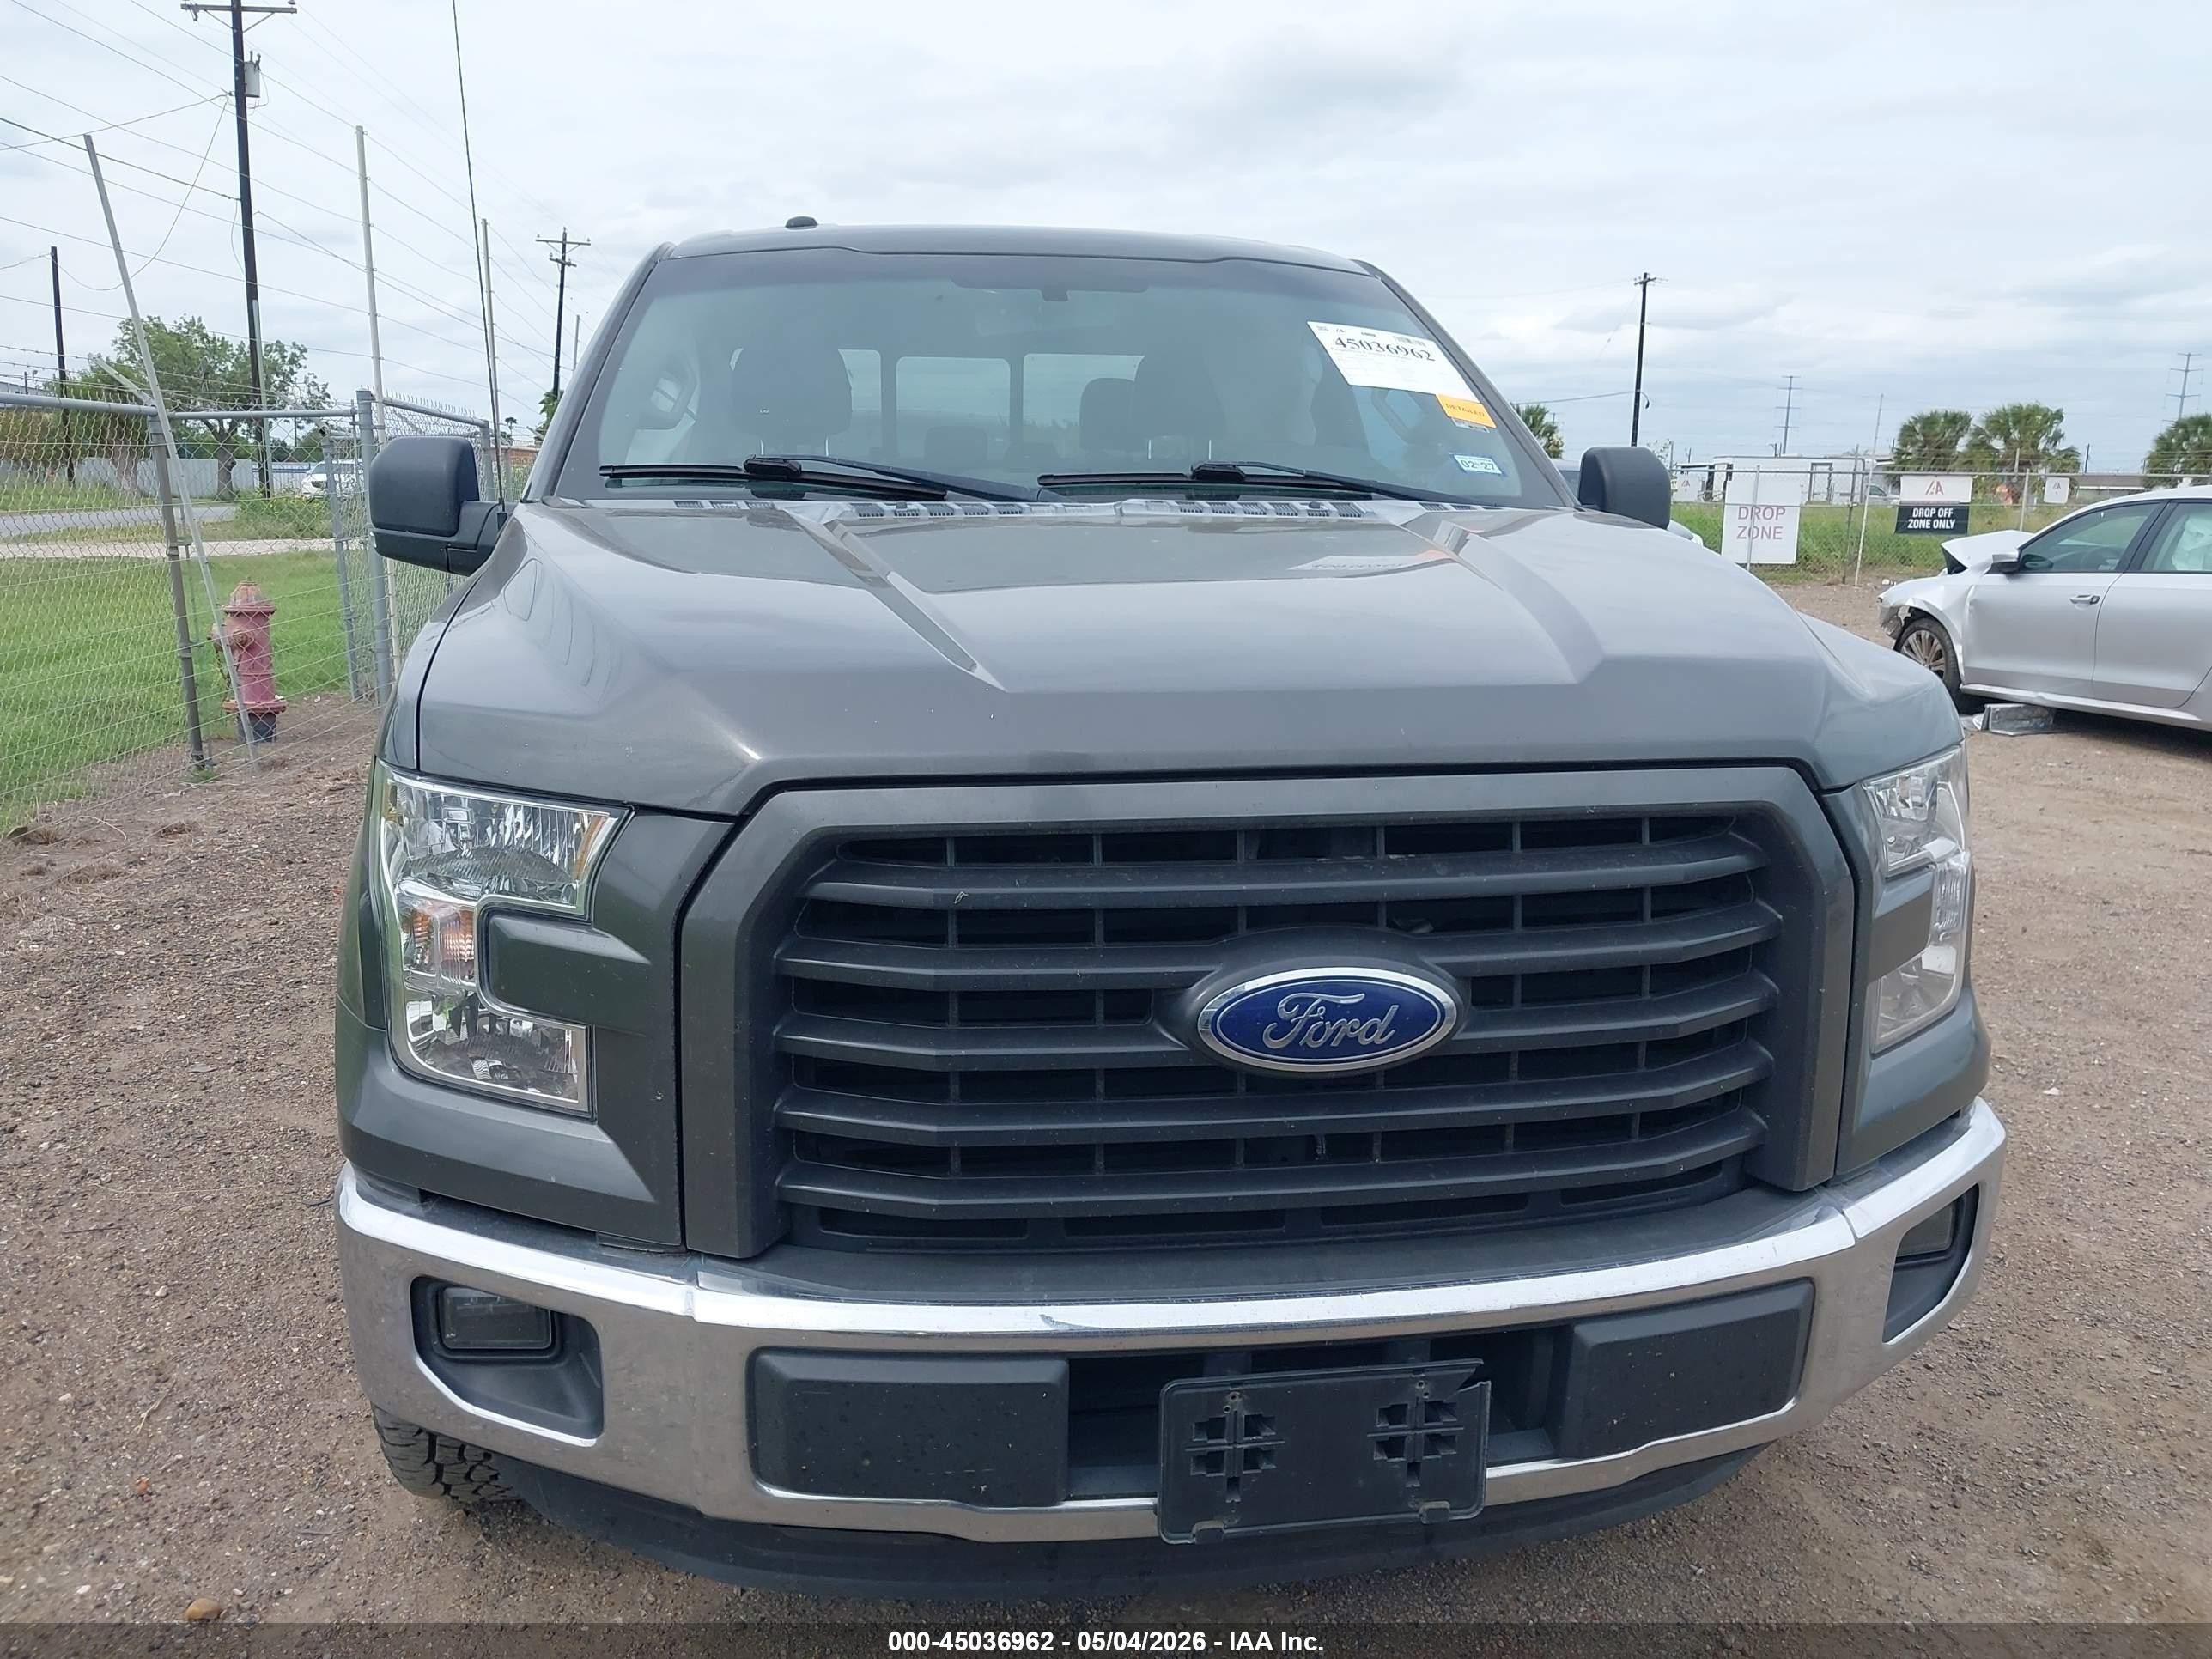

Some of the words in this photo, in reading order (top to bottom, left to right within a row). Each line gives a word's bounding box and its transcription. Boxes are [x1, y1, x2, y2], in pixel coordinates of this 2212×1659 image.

[1335, 336, 1436, 362] 45036962
[1461, 459, 1478, 469] 02
[1738, 506, 1786, 520] DROP
[1912, 507, 1936, 518] DROP
[1937, 507, 1954, 518] OFF
[1907, 519, 1931, 529] ZONE
[1933, 519, 1956, 529] ONLY
[1736, 526, 1784, 540] ZONE
[1262, 992, 1399, 1049] Ford
